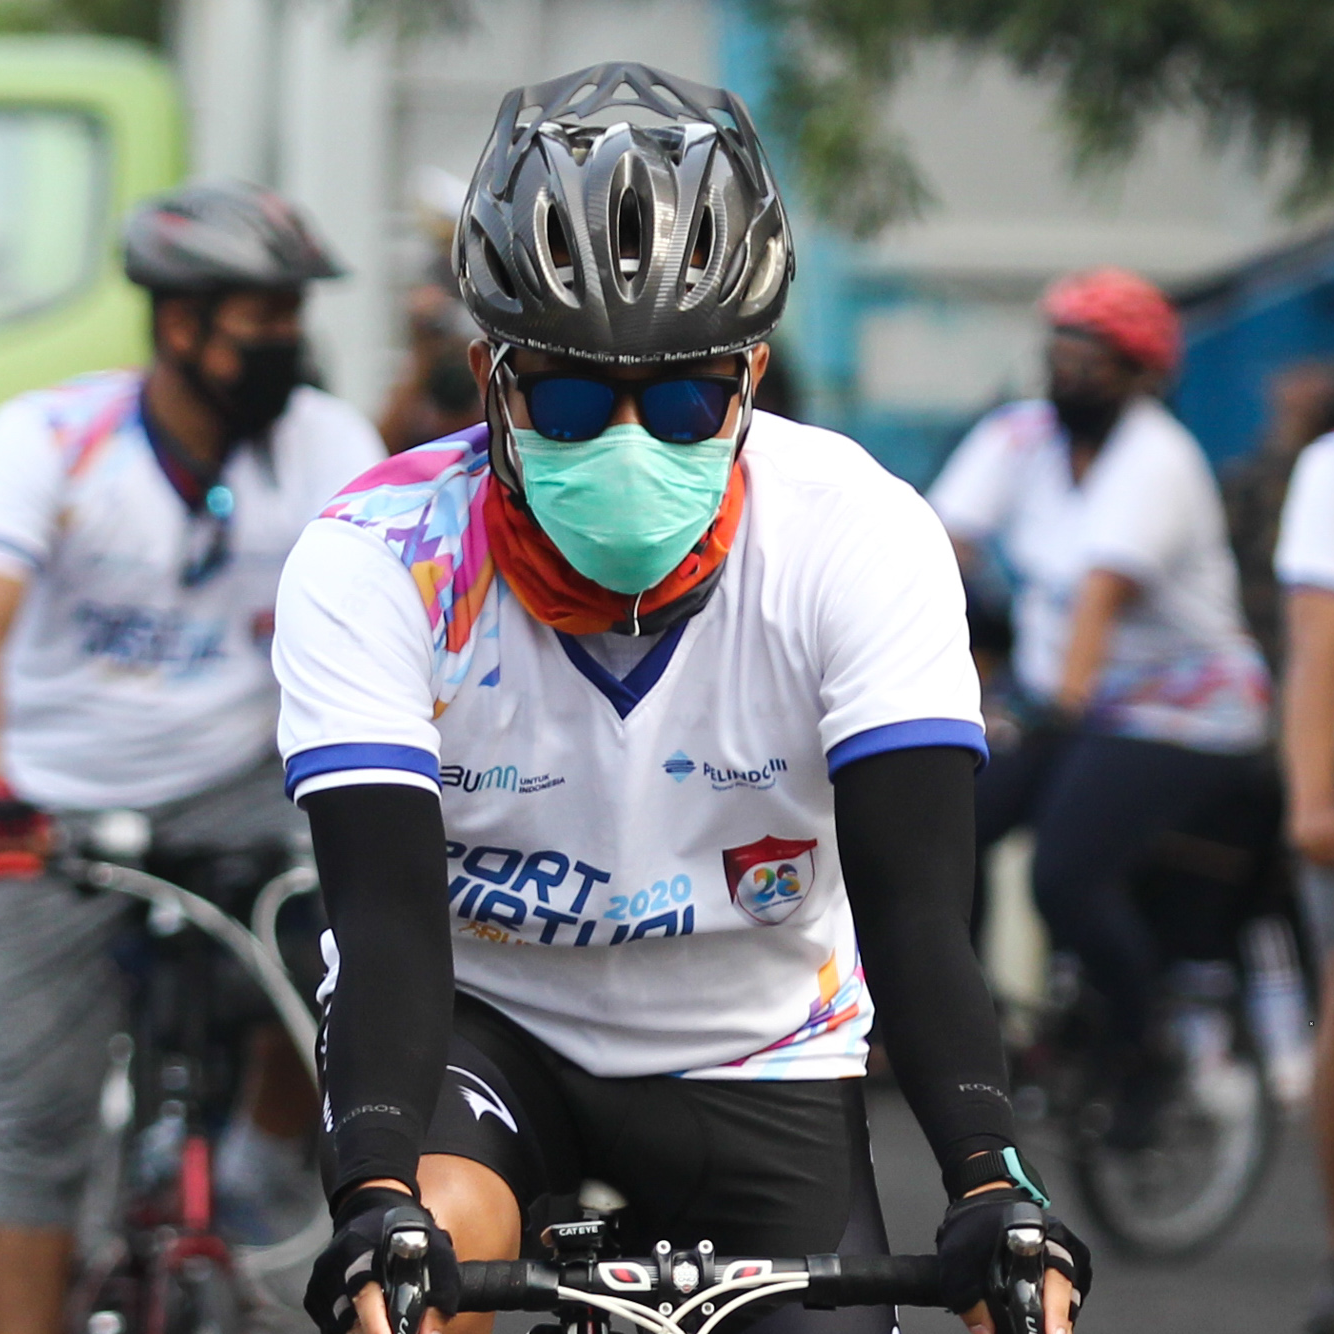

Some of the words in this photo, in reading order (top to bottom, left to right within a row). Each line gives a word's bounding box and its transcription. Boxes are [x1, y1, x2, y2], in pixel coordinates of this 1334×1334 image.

[519, 773, 550, 786] UNTUK
[519, 776, 566, 794] INDONESIA
[753, 863, 801, 905] 28
[603, 873, 692, 920] 2020
[558, 1225, 598, 1237] CATEYE
